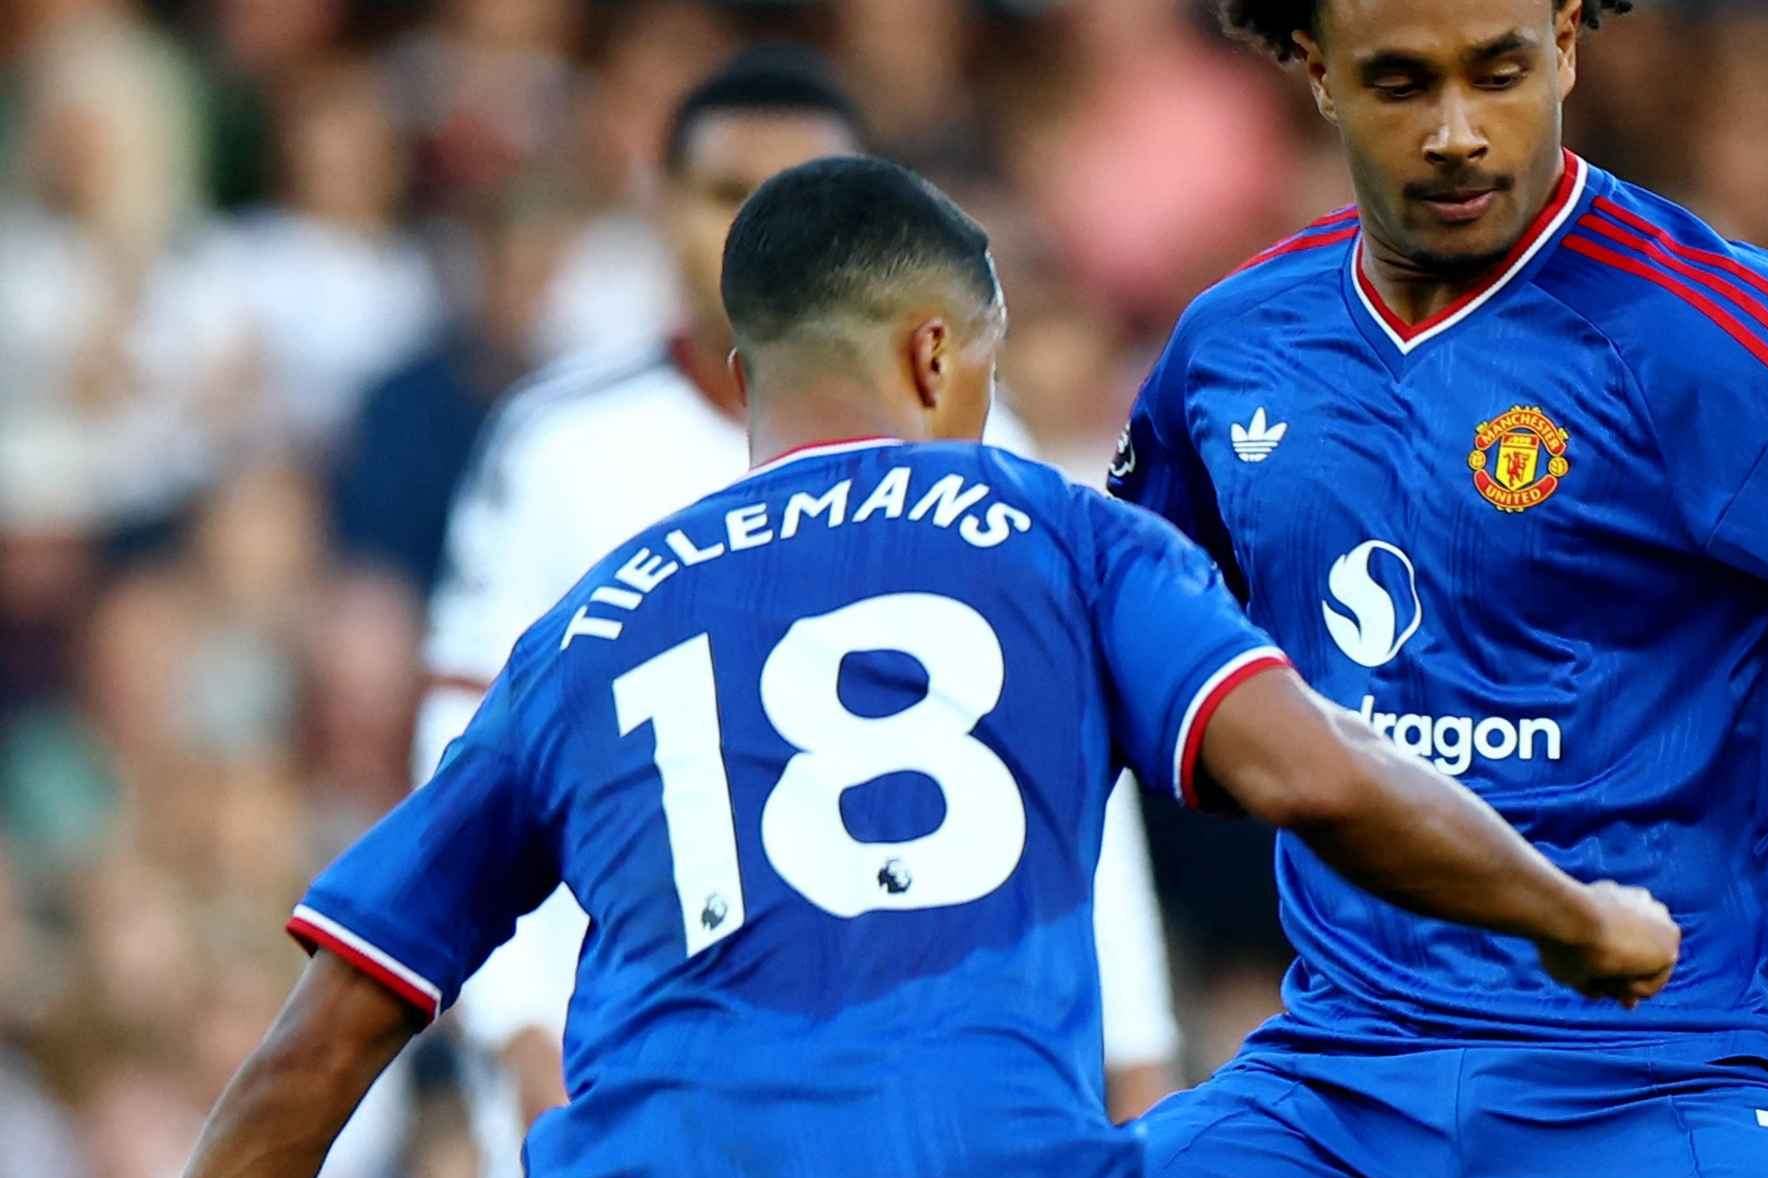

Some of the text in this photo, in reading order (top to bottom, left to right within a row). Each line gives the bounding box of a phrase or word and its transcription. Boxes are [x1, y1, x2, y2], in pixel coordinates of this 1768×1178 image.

[1482, 413, 1560, 451] MANCHESTER
[1485, 485, 1541, 506] UNITED
[560, 467, 1031, 651] TIELEMANS
[612, 591, 1027, 959] 18
